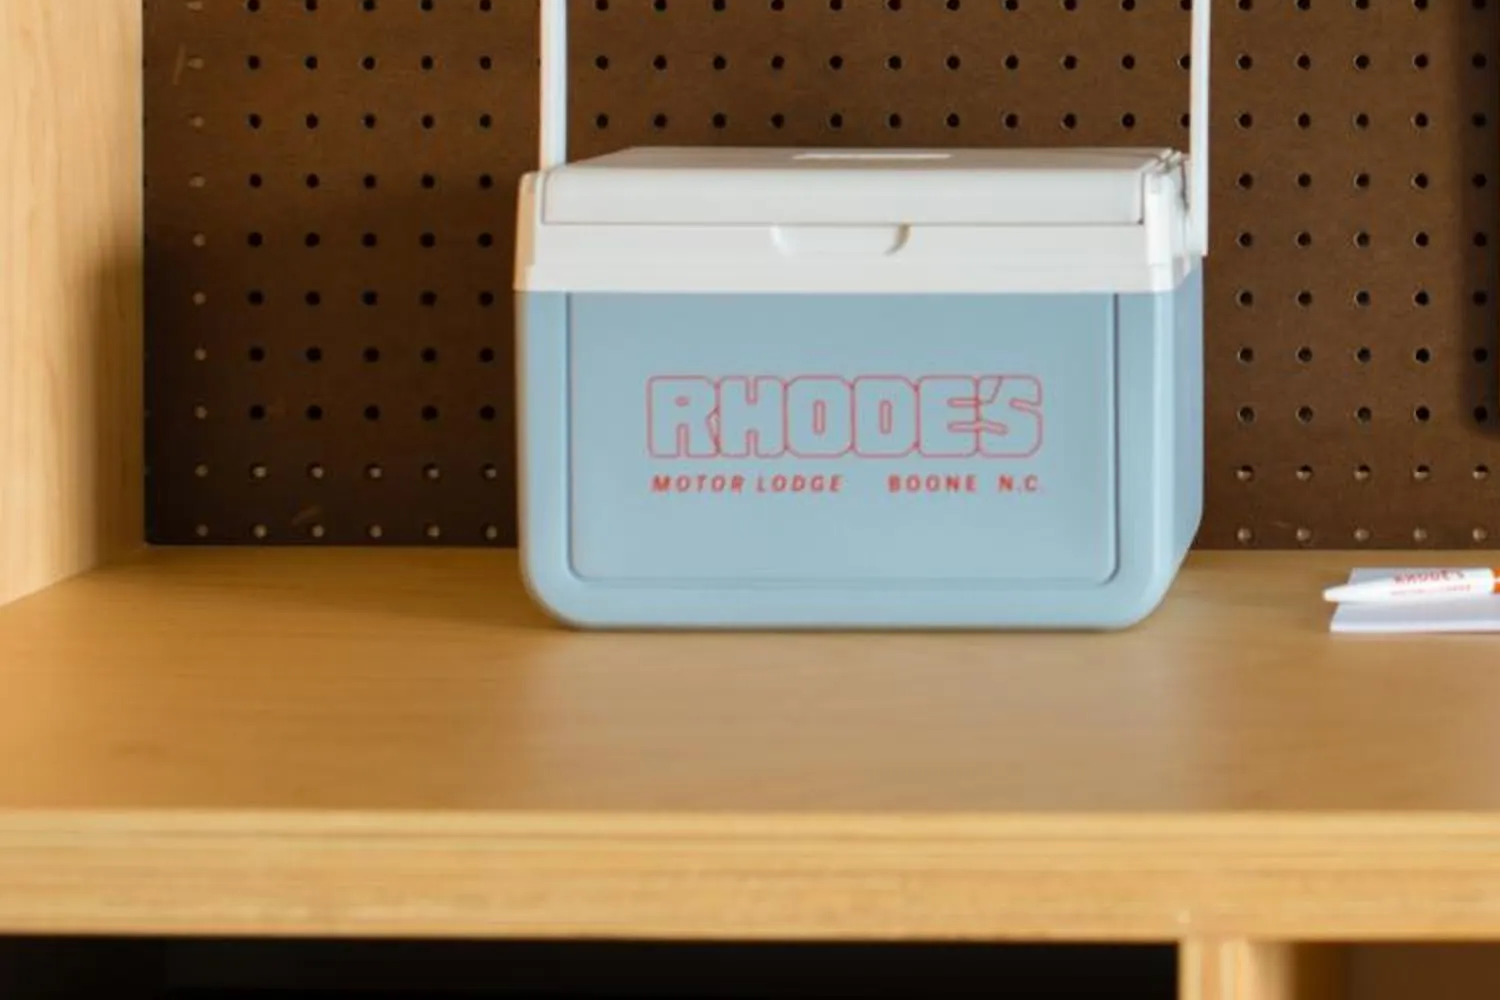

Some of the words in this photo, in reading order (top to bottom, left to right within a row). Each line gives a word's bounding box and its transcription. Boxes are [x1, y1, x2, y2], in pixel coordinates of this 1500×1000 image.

[646, 374, 1044, 459] RHODE'S
[651, 475, 744, 493] MOTOR
[757, 474, 843, 493] LODGE
[887, 474, 978, 493] BOONE
